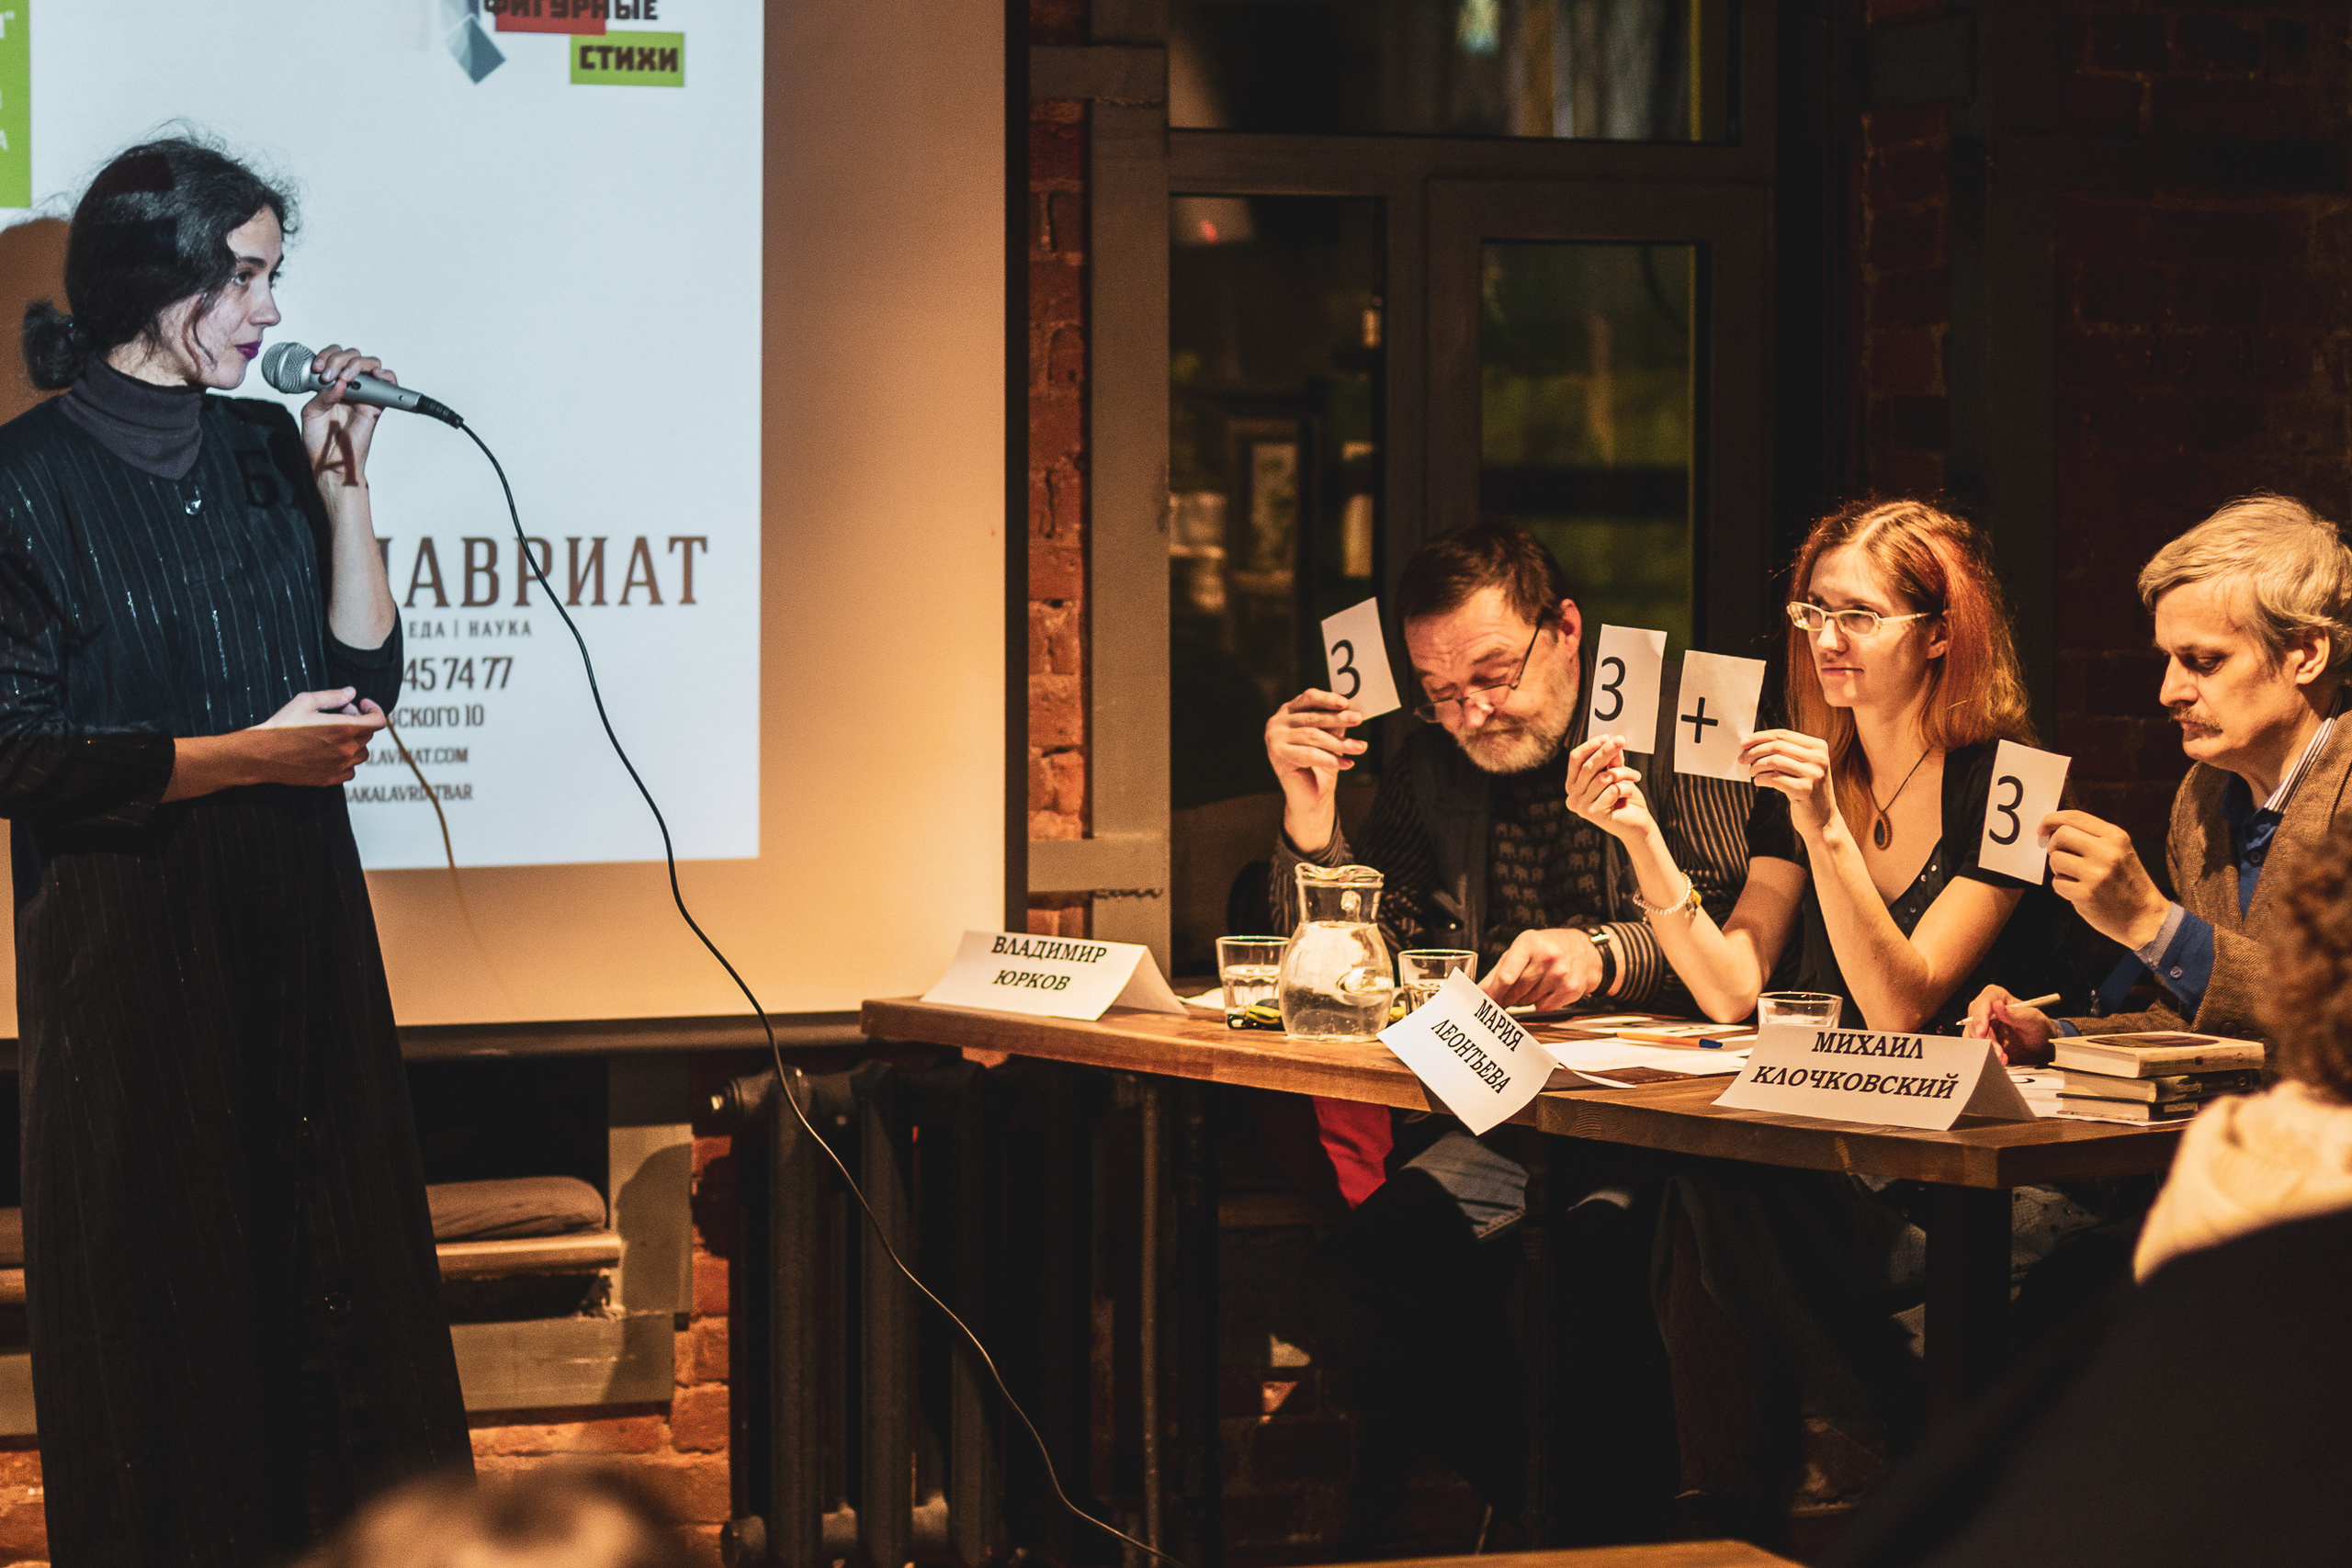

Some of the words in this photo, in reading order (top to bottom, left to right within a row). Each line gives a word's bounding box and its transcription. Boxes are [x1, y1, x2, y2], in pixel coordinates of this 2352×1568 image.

[579, 45, 679, 73] СТИХИ
[409, 621, 446, 638] ЕДА
[469, 621, 533, 637] НАУКА
[443, 657, 474, 690] 74
[482, 656, 514, 690] 77
[1330, 638, 1362, 699] 3
[1593, 656, 1626, 722] 3
[1987, 774, 2024, 846] 3
[991, 935, 1107, 964] ВЛАДИМИР
[992, 969, 1071, 991] ЮРКОВ
[1474, 998, 1524, 1052] МАРИЯ
[1430, 1018, 1511, 1094] ЛЕОНТЬЕВА
[1811, 1031, 1925, 1060] МИХАИЛ
[1749, 1066, 1959, 1100] КЛОЧКОВСКИЙ
